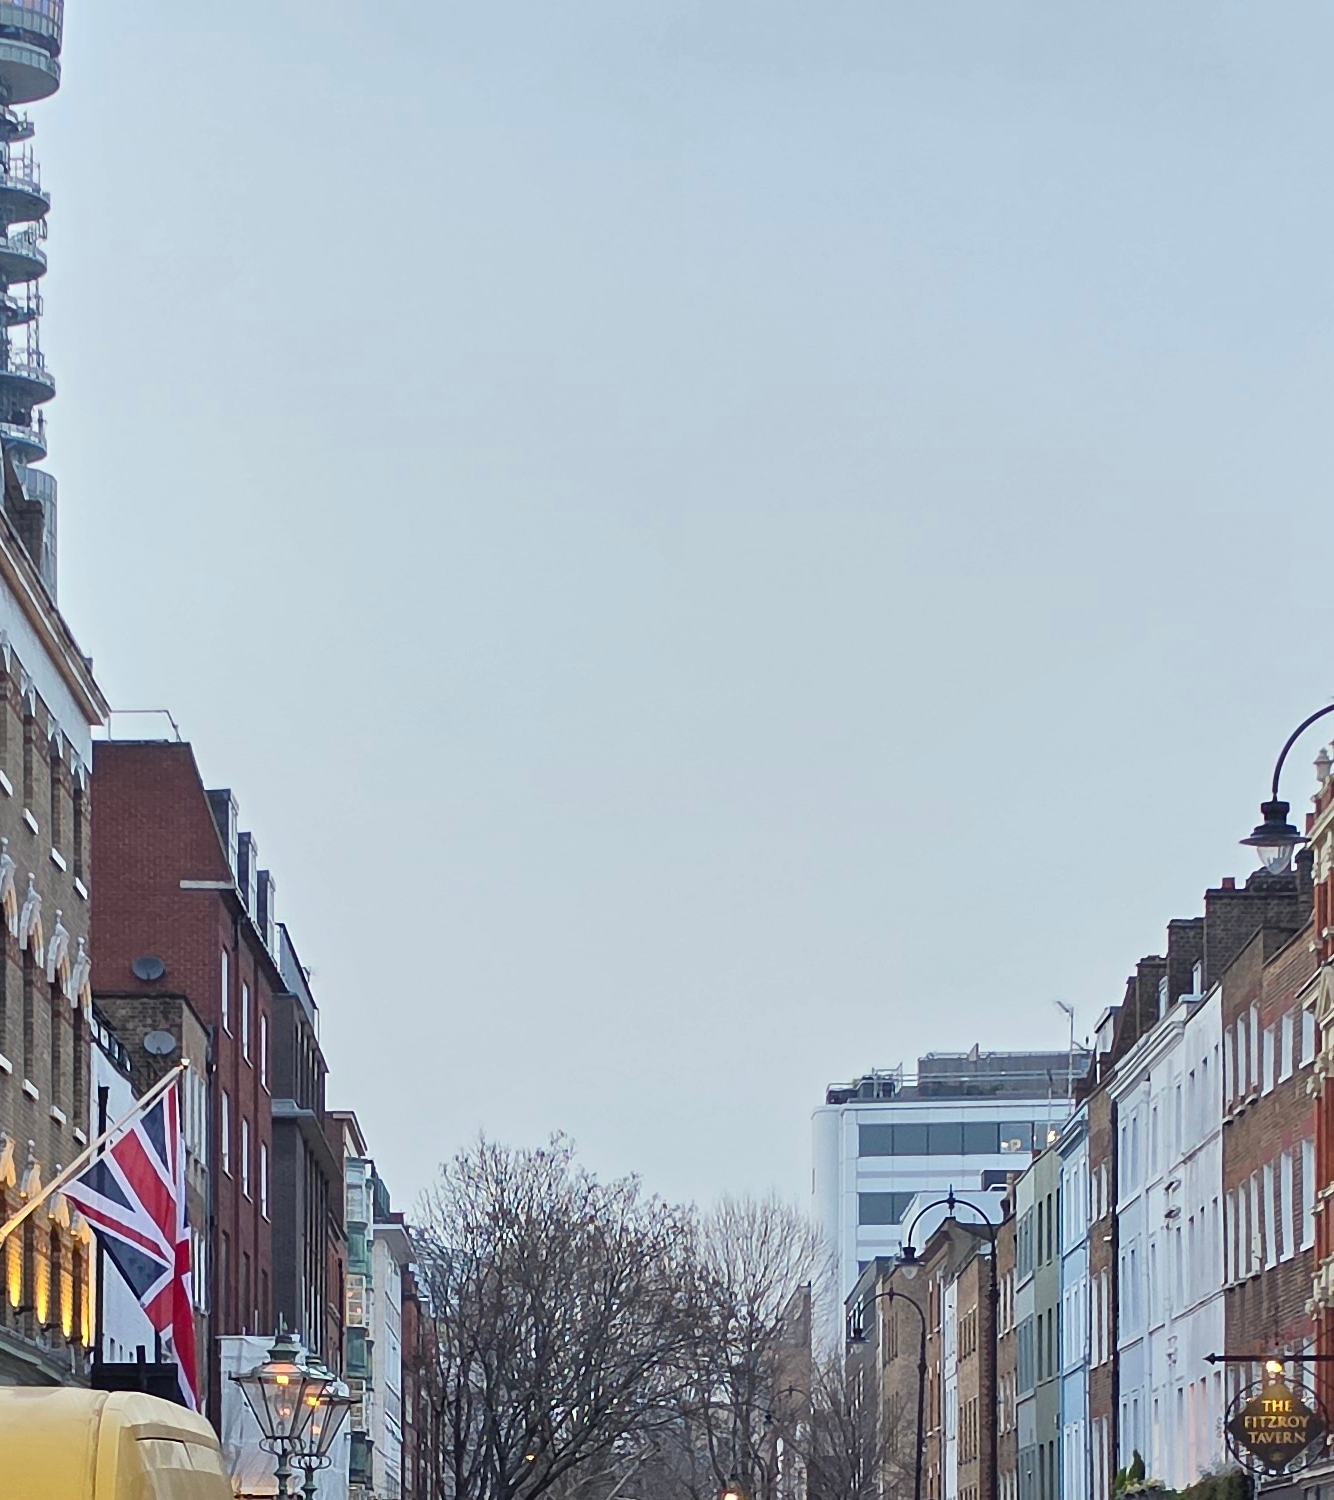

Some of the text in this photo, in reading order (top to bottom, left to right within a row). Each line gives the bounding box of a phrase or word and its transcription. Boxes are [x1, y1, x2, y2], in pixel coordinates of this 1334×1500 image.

[1261, 1399, 1293, 1413] THE
[1244, 1415, 1310, 1428] FITZROY
[1248, 1431, 1306, 1444] TAVERN
